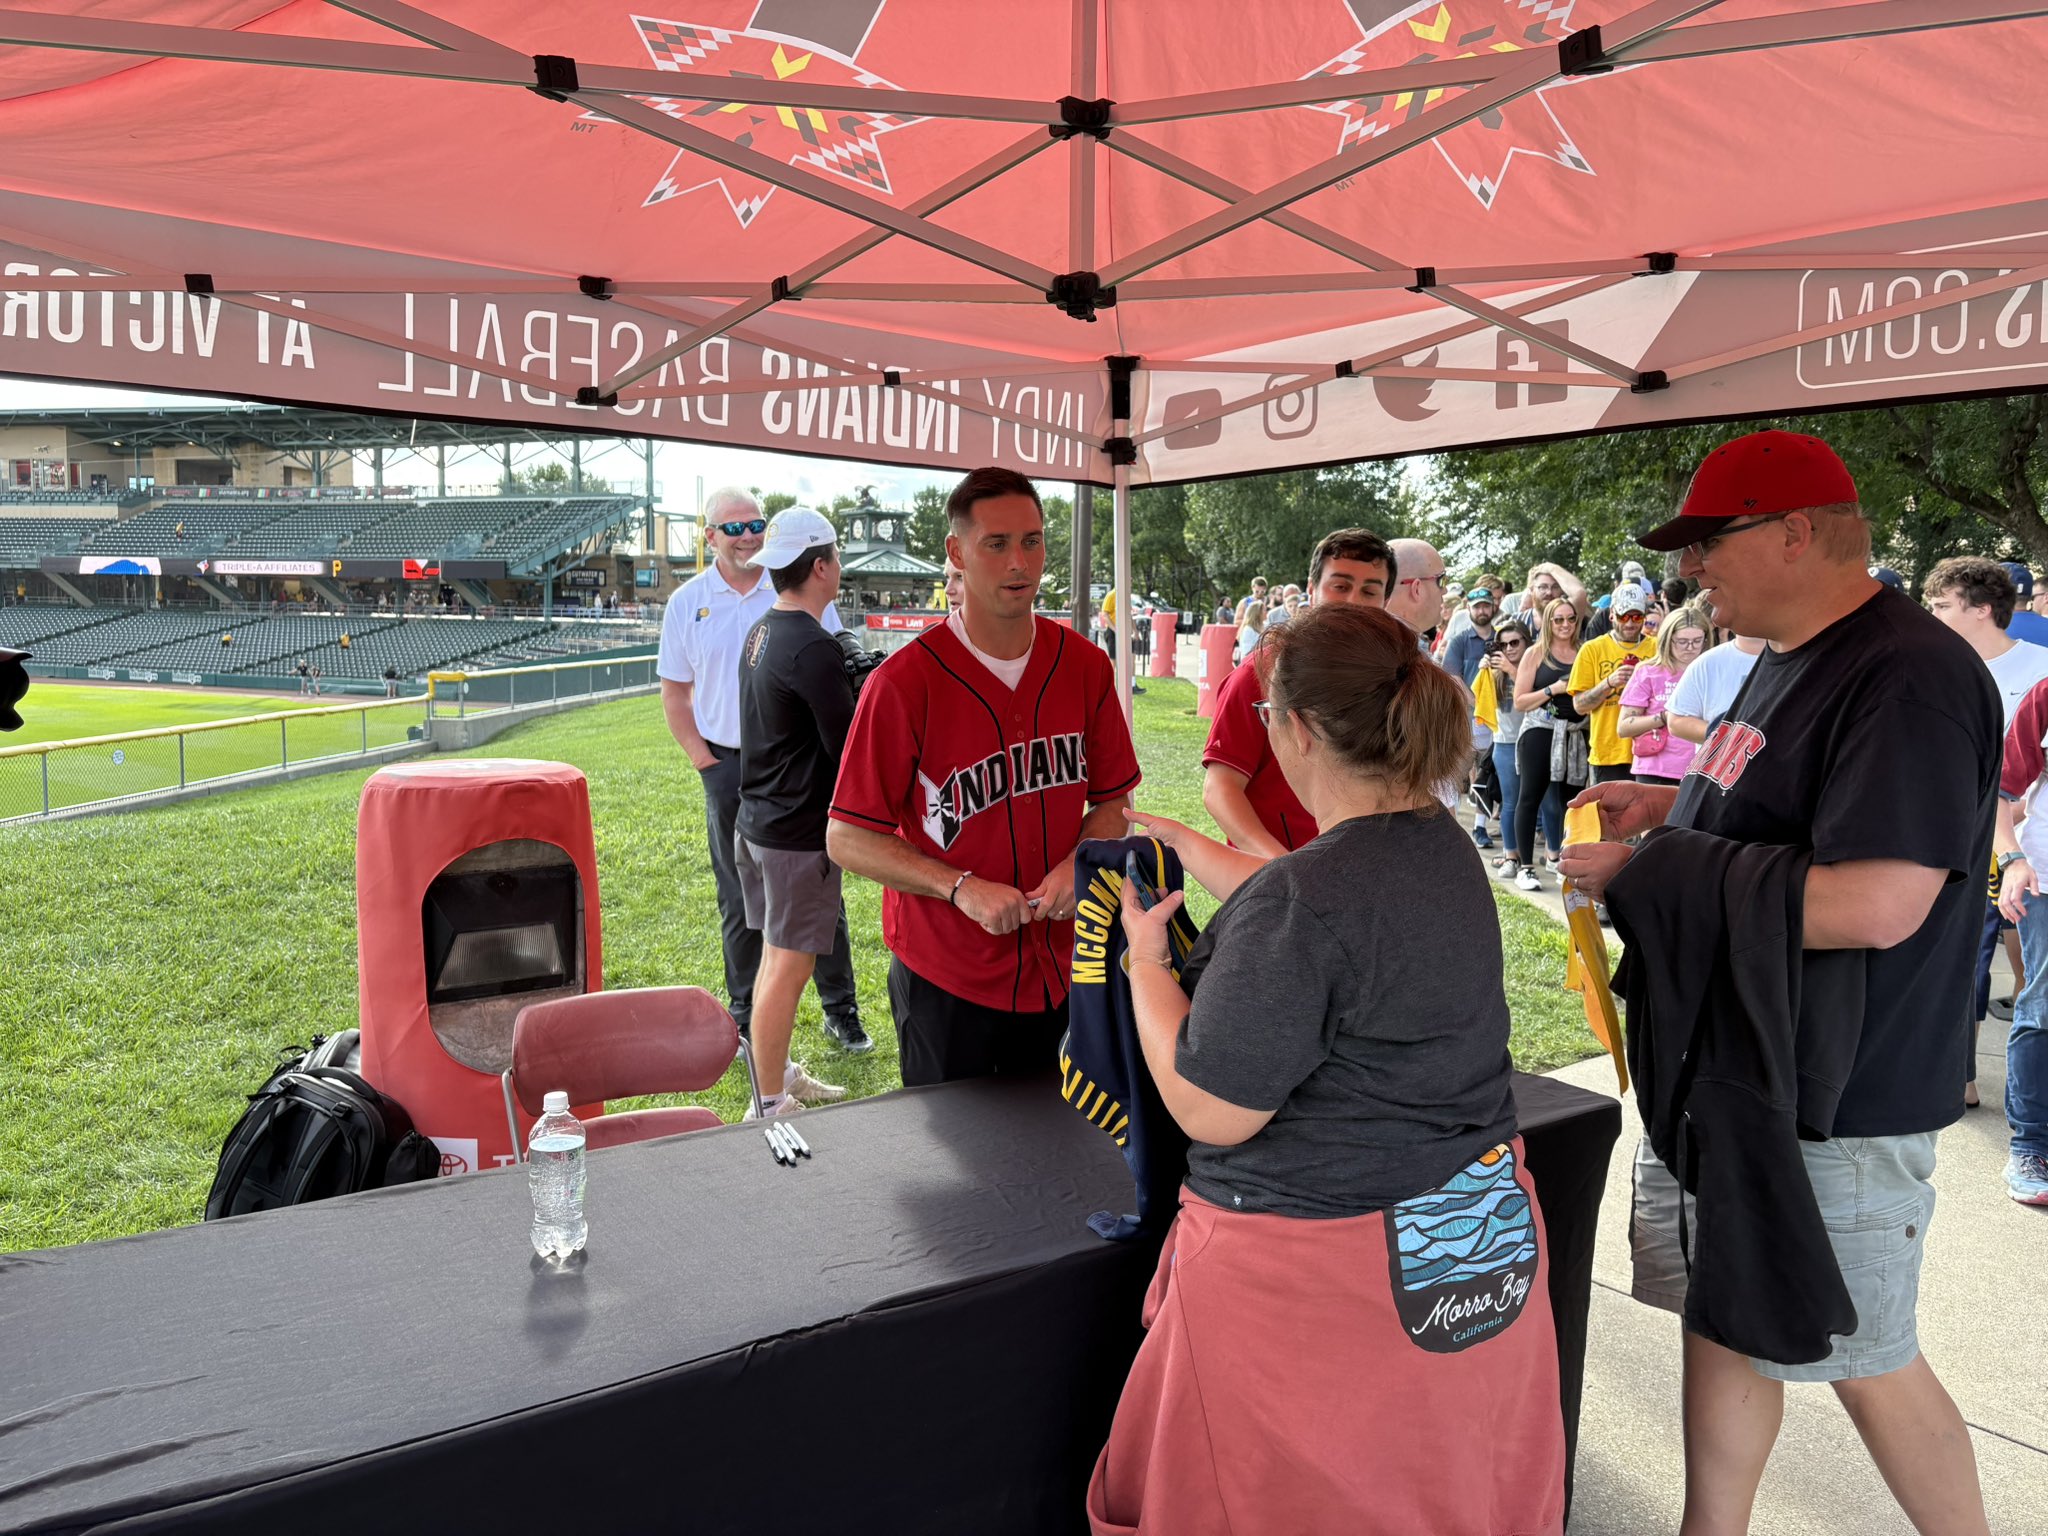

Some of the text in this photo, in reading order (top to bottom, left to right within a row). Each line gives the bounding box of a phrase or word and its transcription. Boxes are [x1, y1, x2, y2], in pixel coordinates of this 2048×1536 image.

[264, 563, 316, 572] AFFILIATES
[1072, 866, 1123, 984] MCCONN
[1494, 1272, 1529, 1312] Bay
[1453, 1316, 1503, 1342] California
